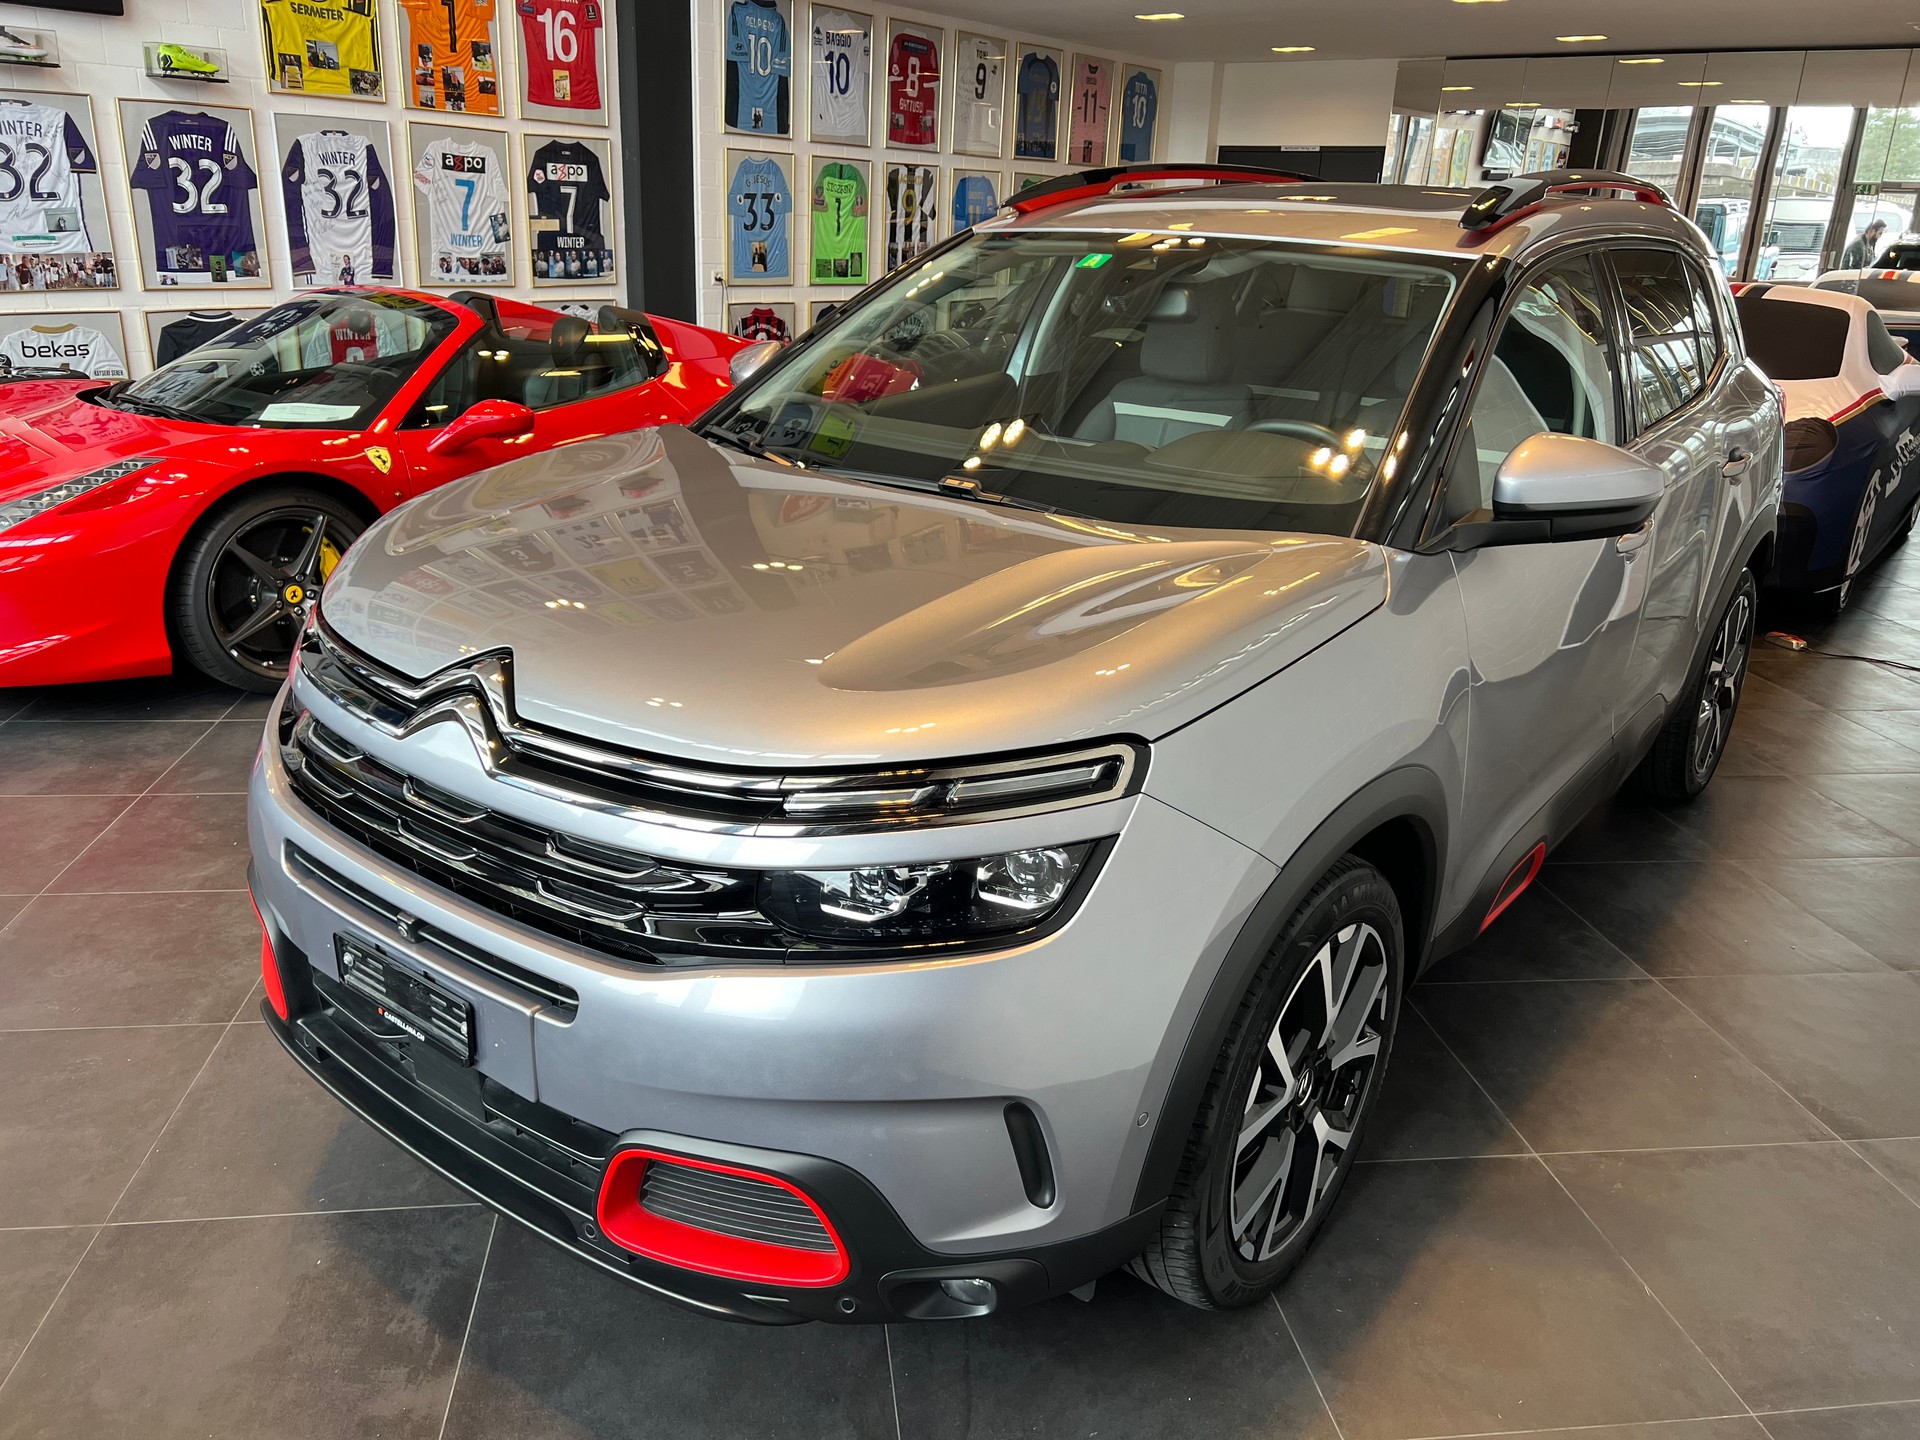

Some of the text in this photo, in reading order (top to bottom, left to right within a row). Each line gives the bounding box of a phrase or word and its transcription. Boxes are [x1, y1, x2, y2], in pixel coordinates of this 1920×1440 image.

[290, 2, 344, 21] SERMETER
[537, 8, 578, 62] 16
[826, 31, 852, 48] BAGGIO
[748, 33, 772, 77] 10
[825, 50, 850, 95] 10
[906, 56, 920, 97] 8
[975, 62, 987, 99] 9
[1083, 89, 1098, 123] 11
[1132, 94, 1147, 128] 10
[0, 120, 42, 138] INTER
[168, 134, 213, 153] WINTER
[318, 151, 356, 167] WINTER
[168, 157, 229, 215] 32
[317, 168, 368, 219] 32
[753, 174, 772, 188] JESUS
[455, 178, 475, 231] 7
[560, 185, 577, 234] 7
[743, 193, 776, 232] 33
[835, 197, 842, 237] 1
[450, 232, 483, 248] WINTER
[557, 236, 585, 249] WINTER
[21, 340, 90, 359] bekaş
